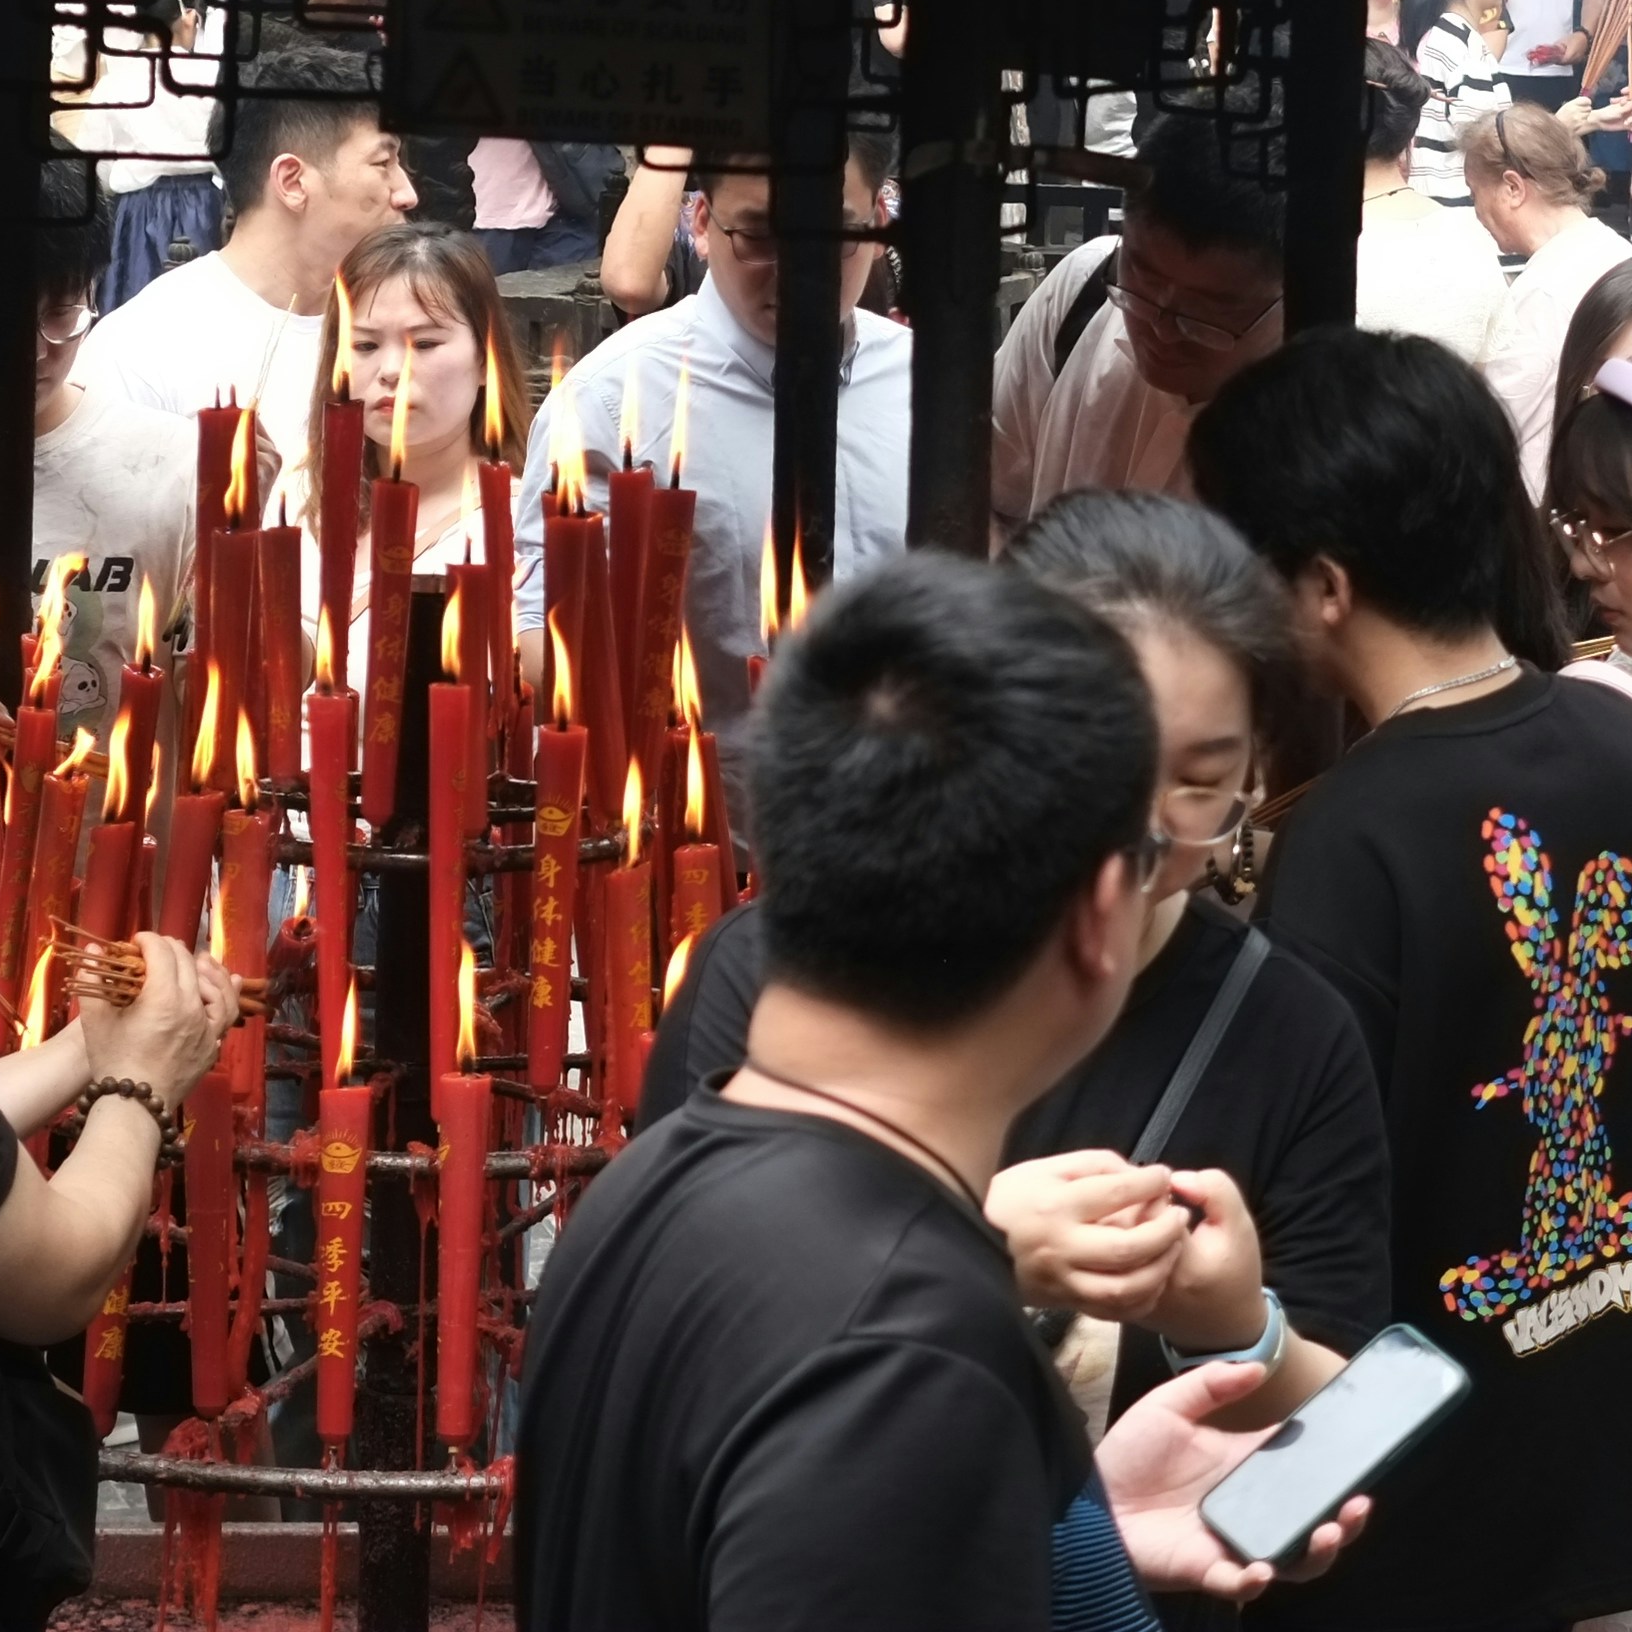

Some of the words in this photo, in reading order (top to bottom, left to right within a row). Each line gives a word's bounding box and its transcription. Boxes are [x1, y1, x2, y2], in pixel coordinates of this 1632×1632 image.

[517, 54, 745, 110] 当心扎手
[522, 16, 607, 37] BEWARE
[610, 20, 640, 39] OF
[643, 23, 749, 45] SCALDING
[515, 107, 604, 129] BEWARE
[606, 111, 637, 131] OF
[638, 113, 745, 136] STABBING
[369, 592, 406, 745] 身体健康
[531, 854, 563, 1009] 身体健康
[317, 1200, 353, 1359] 四季平安
